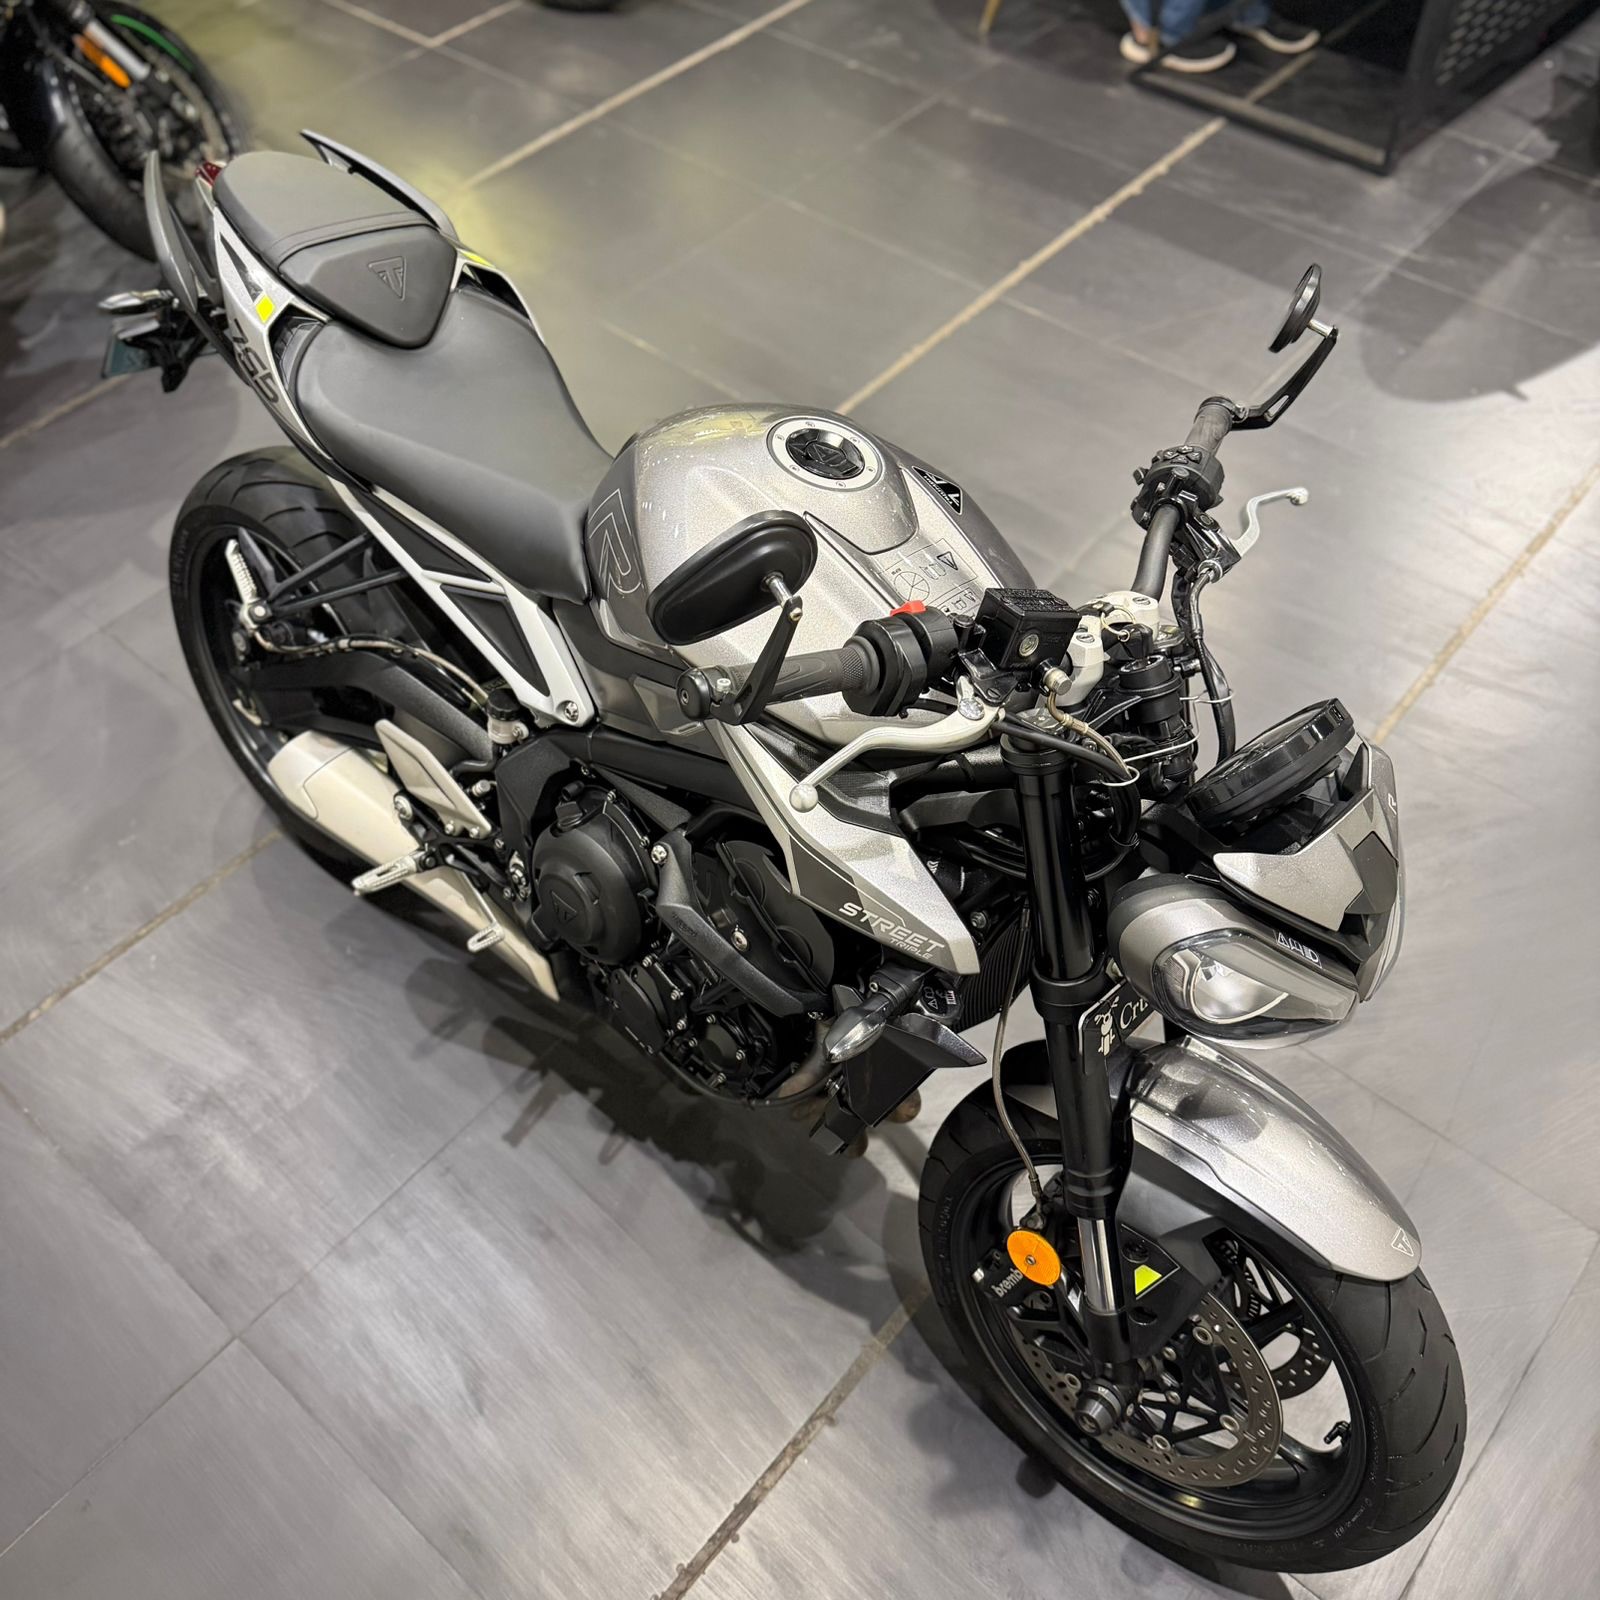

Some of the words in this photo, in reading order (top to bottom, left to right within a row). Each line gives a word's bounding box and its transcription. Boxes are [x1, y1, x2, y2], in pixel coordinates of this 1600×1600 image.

[838, 902, 945, 953] STREET
[889, 937, 934, 960] TRIPLE
[991, 1267, 1024, 1298] bremb
